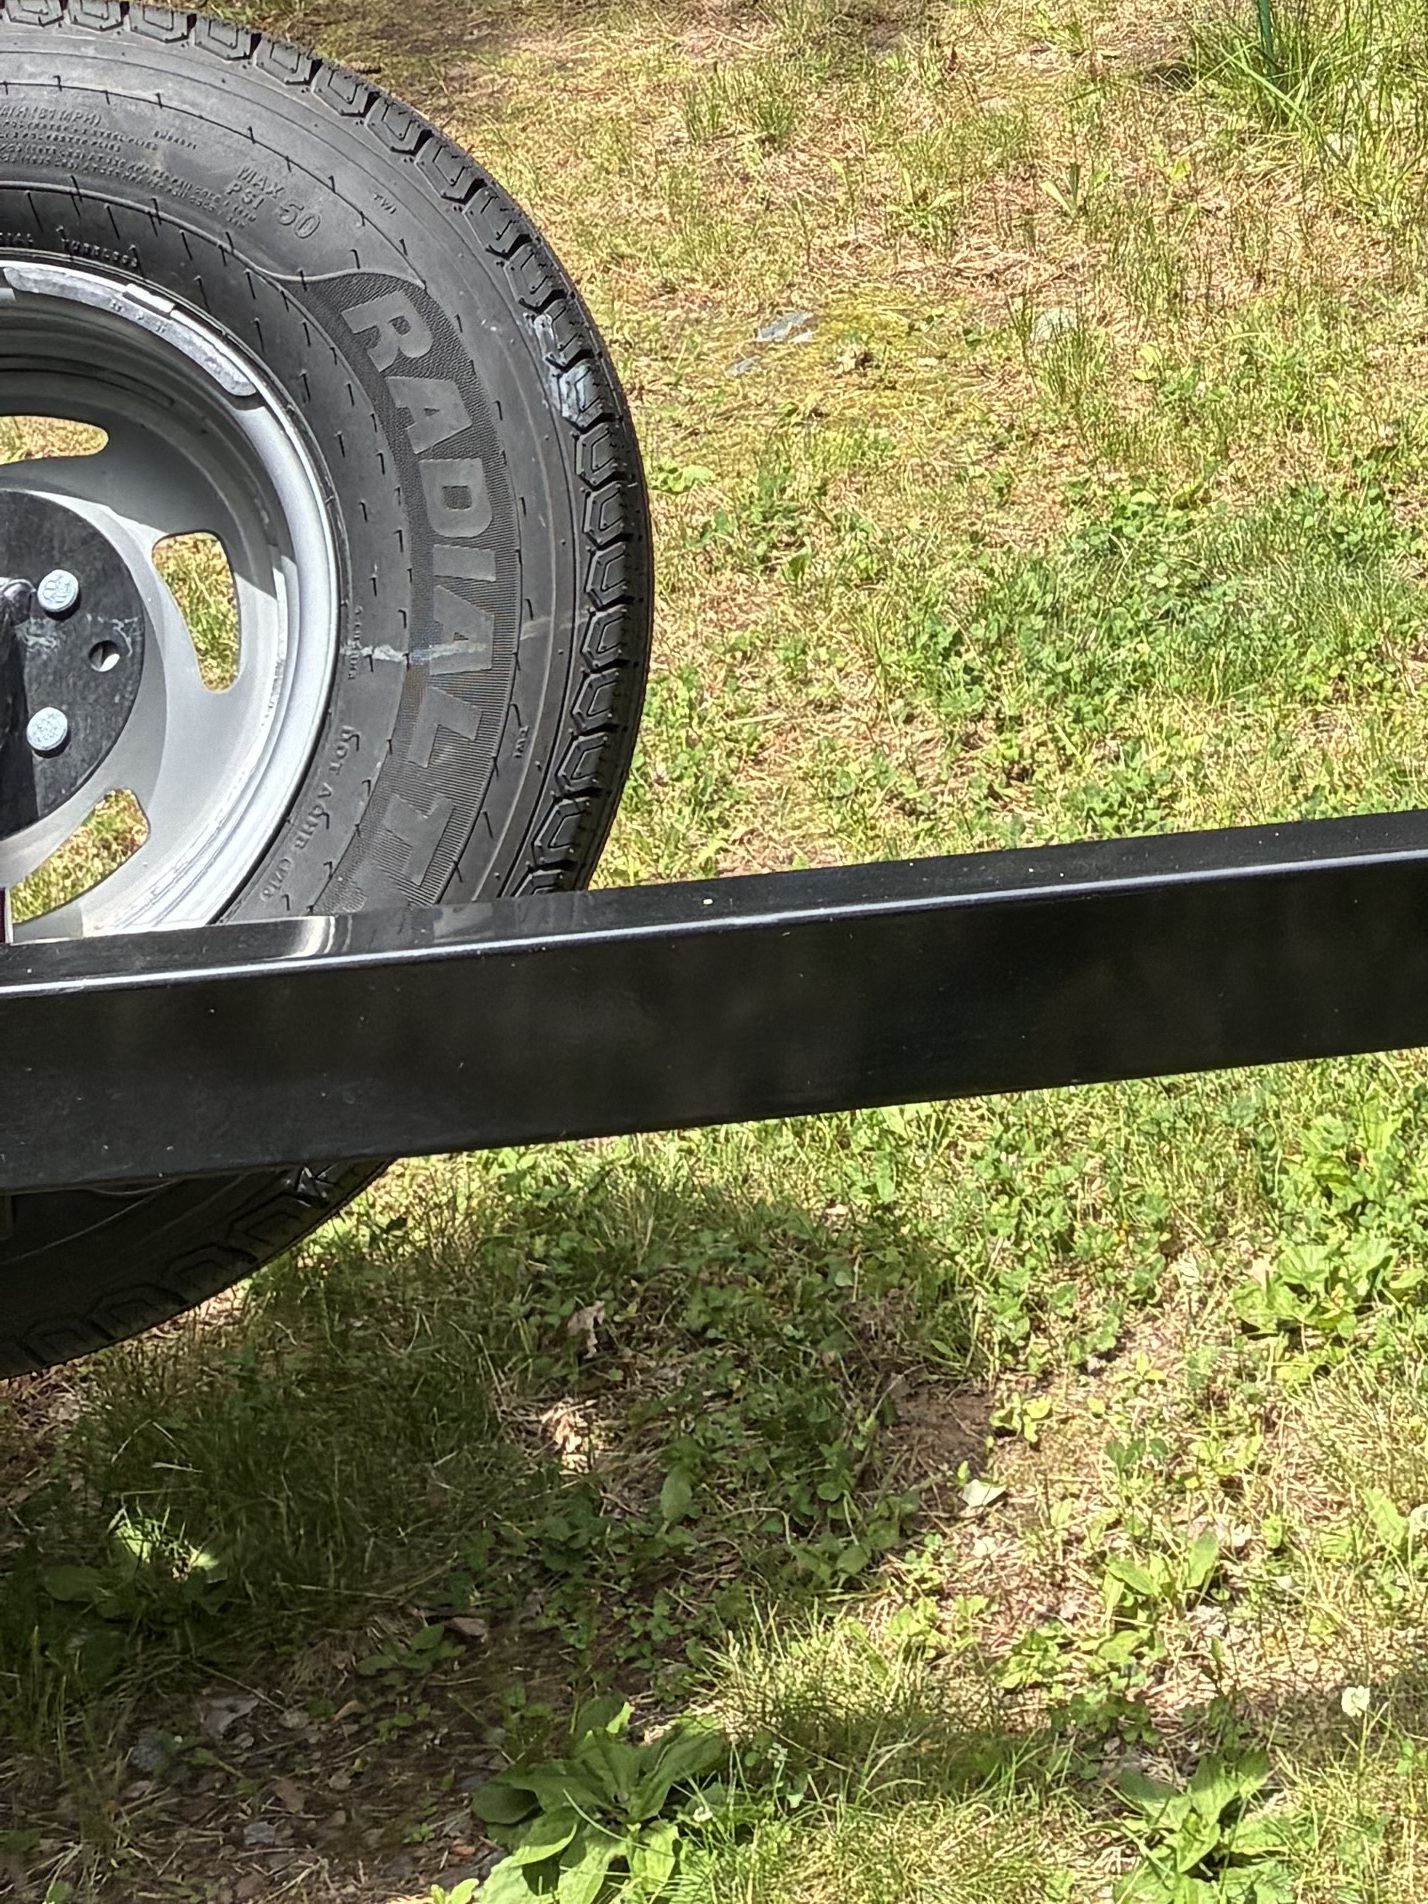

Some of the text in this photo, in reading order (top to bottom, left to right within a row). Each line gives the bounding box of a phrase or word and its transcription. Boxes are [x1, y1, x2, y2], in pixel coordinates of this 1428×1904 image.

[226, 182, 264, 211] PSI
[276, 202, 321, 240] 50
[236, 165, 284, 200] MAX
[341, 291, 495, 769] RADIAL
